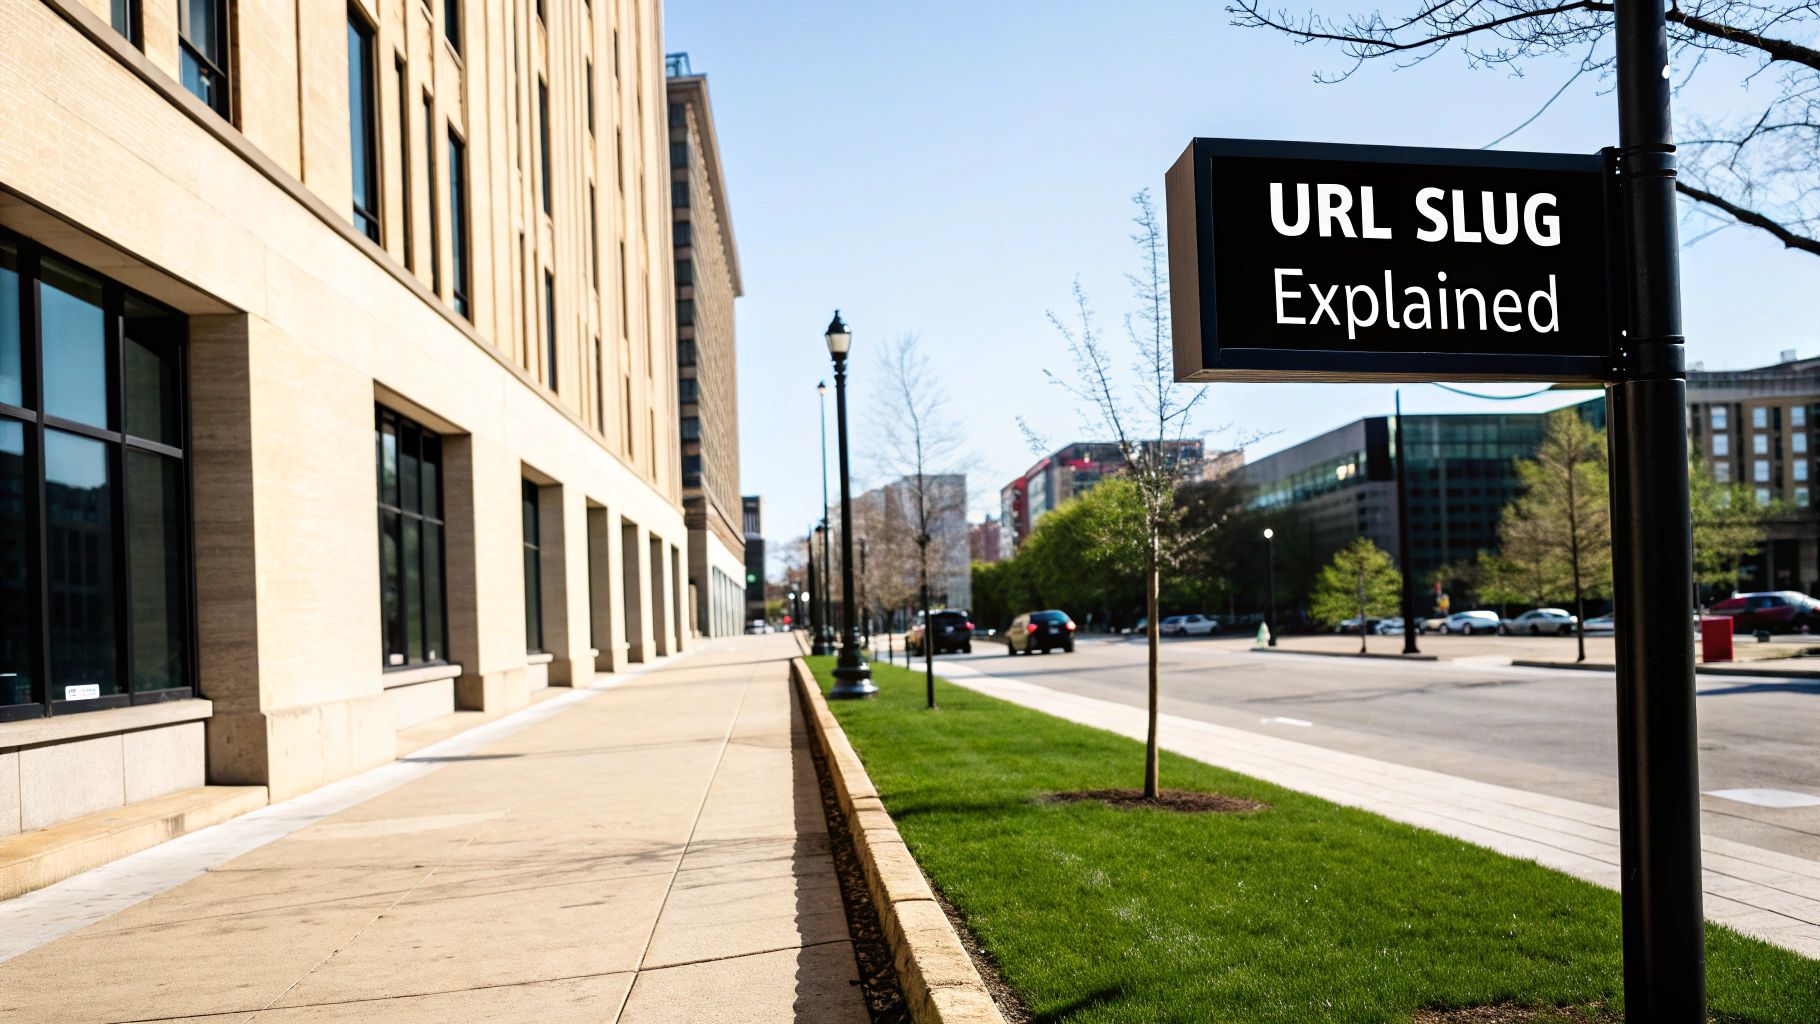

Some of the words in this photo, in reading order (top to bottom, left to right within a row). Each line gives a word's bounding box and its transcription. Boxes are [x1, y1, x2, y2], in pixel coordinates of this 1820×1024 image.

[1269, 182, 1393, 240] URL
[1415, 186, 1561, 247] SLUG
[1274, 267, 1560, 340] Explained
